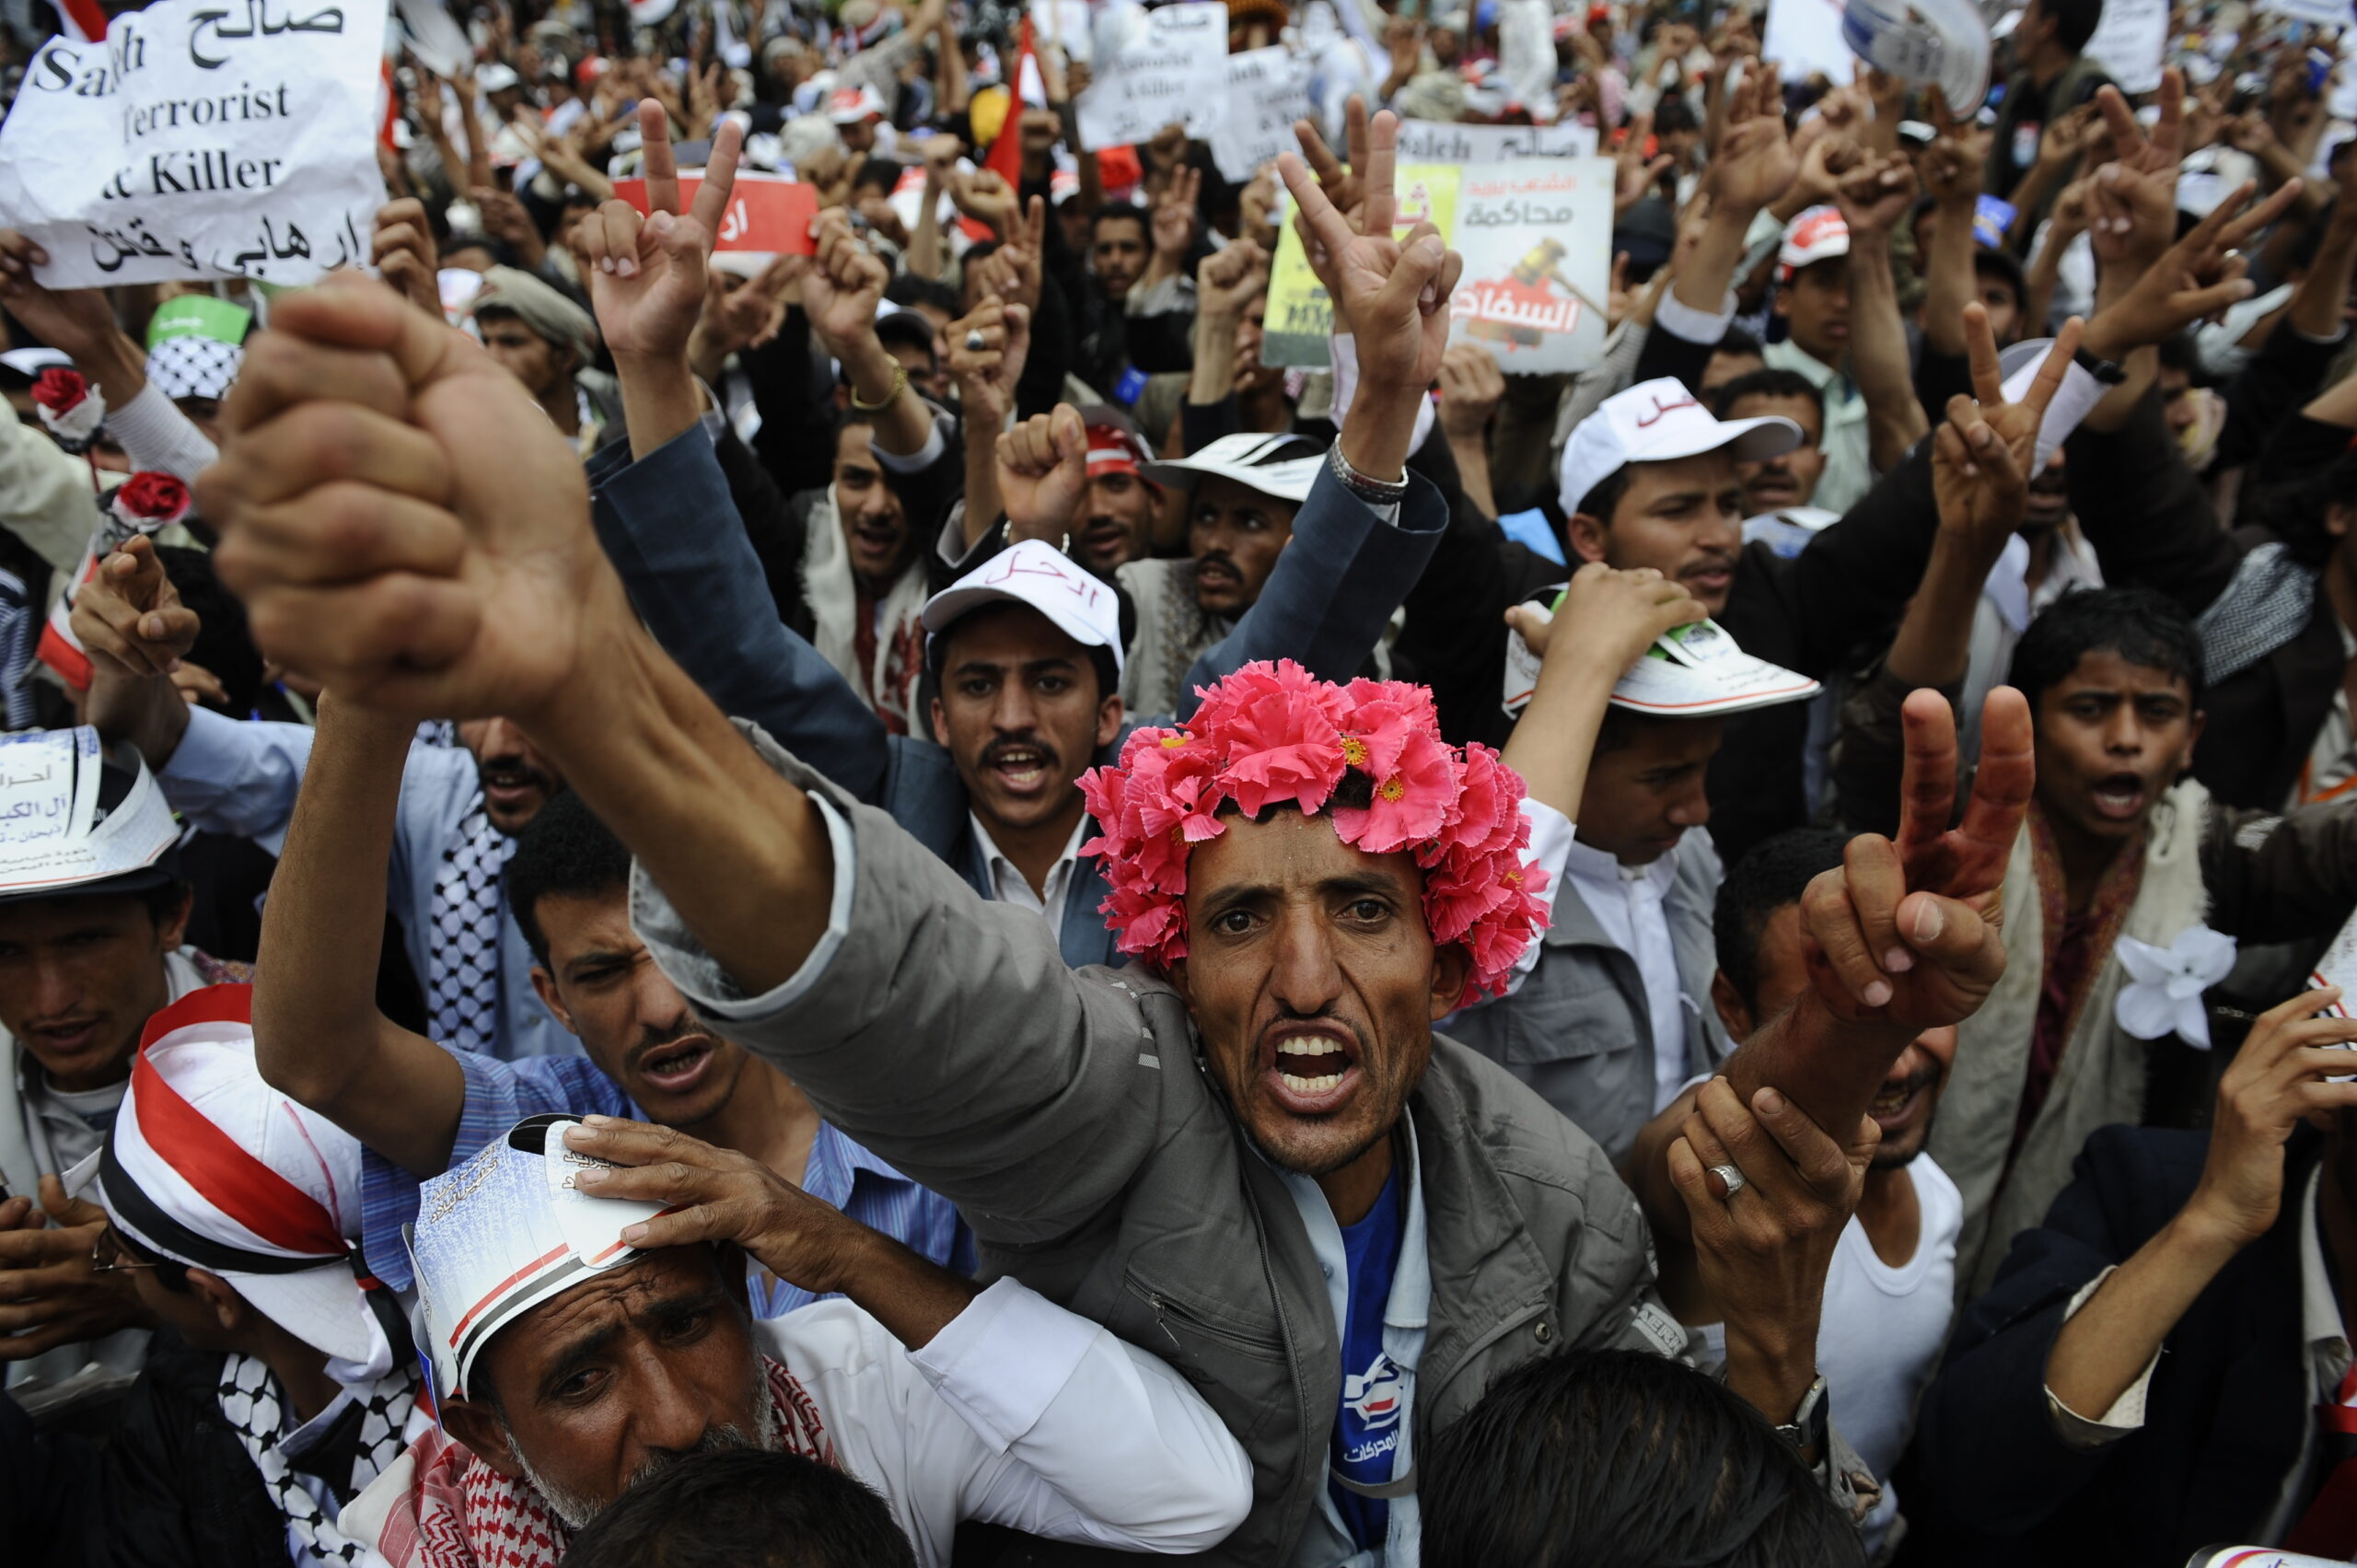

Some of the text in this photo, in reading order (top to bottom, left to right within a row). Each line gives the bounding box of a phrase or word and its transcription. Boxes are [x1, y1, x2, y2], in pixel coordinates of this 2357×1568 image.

[188, 0, 344, 69] صالح
[149, 147, 283, 196] Killer
[1465, 199, 1574, 228] محاكمة
[1450, 285, 1581, 333] السفاح
[0, 801, 41, 828] الكب
